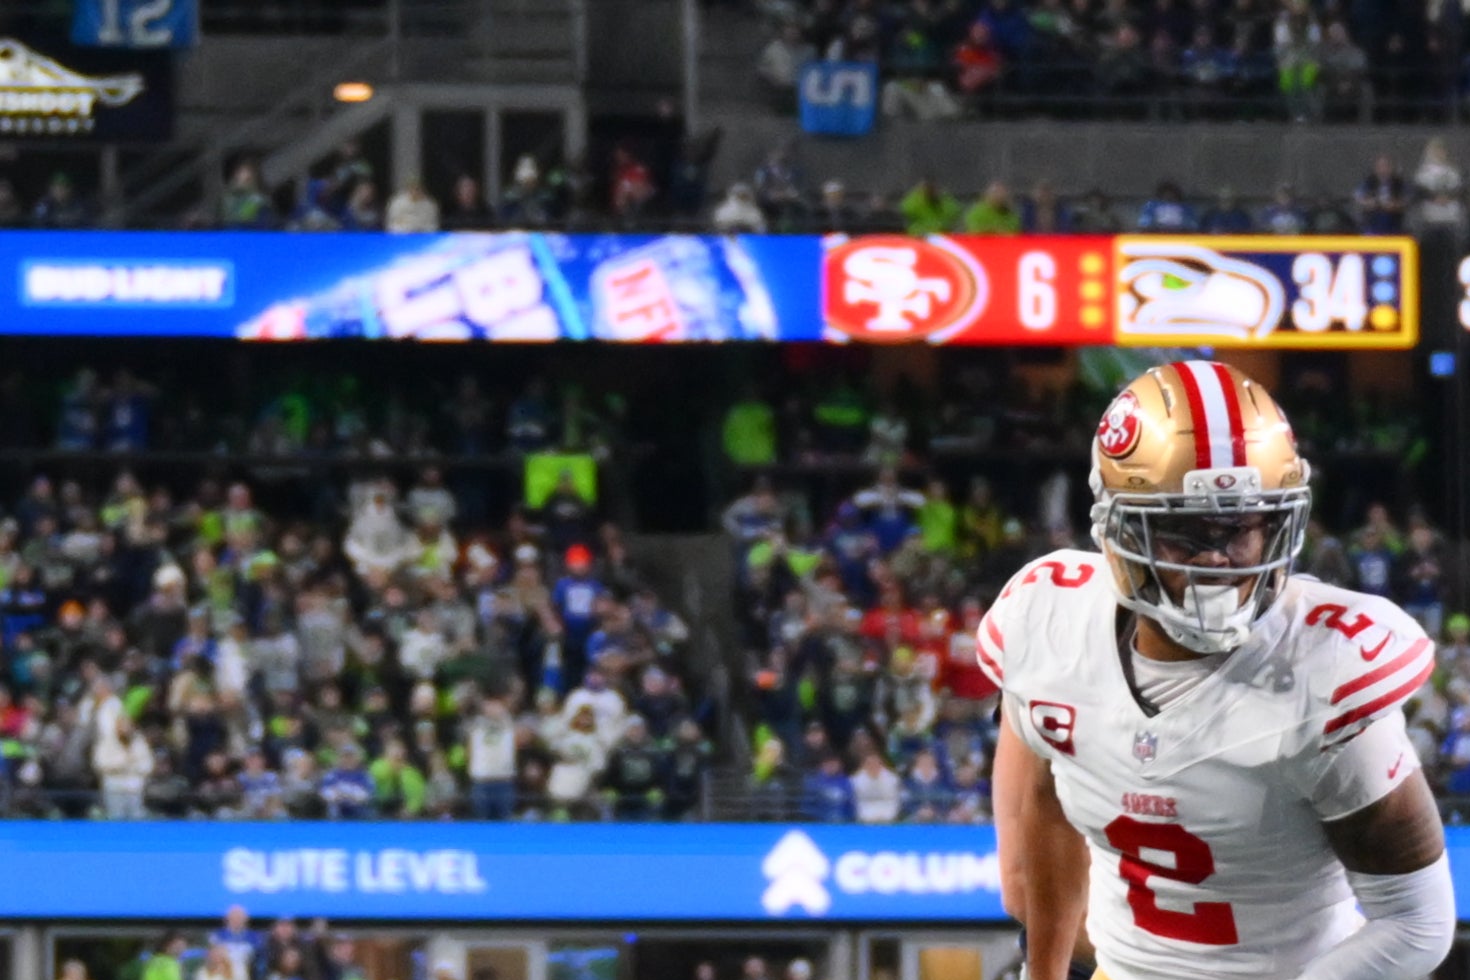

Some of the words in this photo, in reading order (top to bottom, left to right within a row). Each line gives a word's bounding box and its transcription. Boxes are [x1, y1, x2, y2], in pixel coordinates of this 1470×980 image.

[1017, 251, 1056, 331] 6
[1292, 252, 1366, 331] 34
[1304, 603, 1375, 640] 2
[1031, 705, 1071, 743] C
[1121, 792, 1179, 817] 49ERS
[222, 847, 348, 893] SUITE
[354, 848, 489, 893] LEVEL
[1103, 814, 1239, 946] 2
